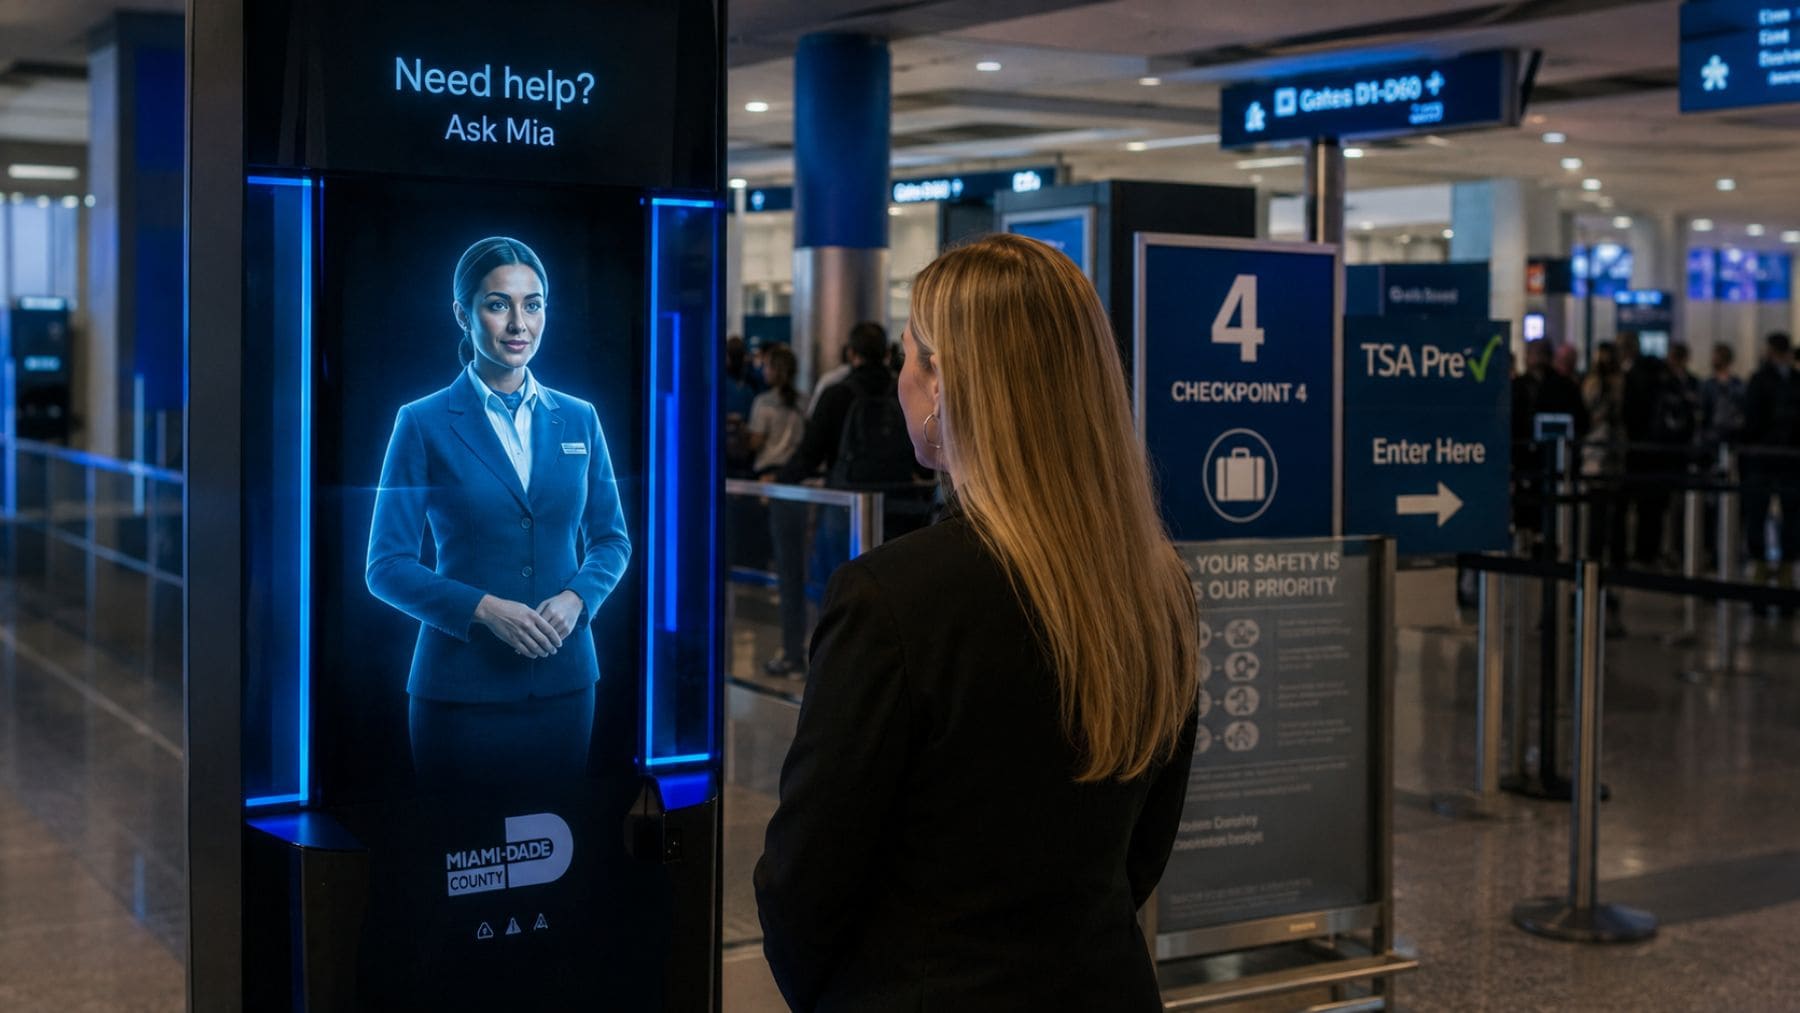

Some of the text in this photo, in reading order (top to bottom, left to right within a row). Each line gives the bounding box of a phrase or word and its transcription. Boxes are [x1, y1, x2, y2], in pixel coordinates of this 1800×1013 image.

[395, 56, 595, 110] Need help?
[1300, 87, 1353, 113] Gates
[445, 113, 555, 146] Ask Mia
[1211, 273, 1265, 363] 4
[1360, 342, 1416, 378] TSA
[1171, 381, 1307, 402] CHECKPOINT 4
[1373, 438, 1485, 464] Enter Here
[1196, 551, 1340, 574] YOUR SAFETY IS
[1208, 580, 1249, 599] OUR
[1254, 577, 1337, 597] PRIORITY
[450, 871, 504, 890] COUNTY
